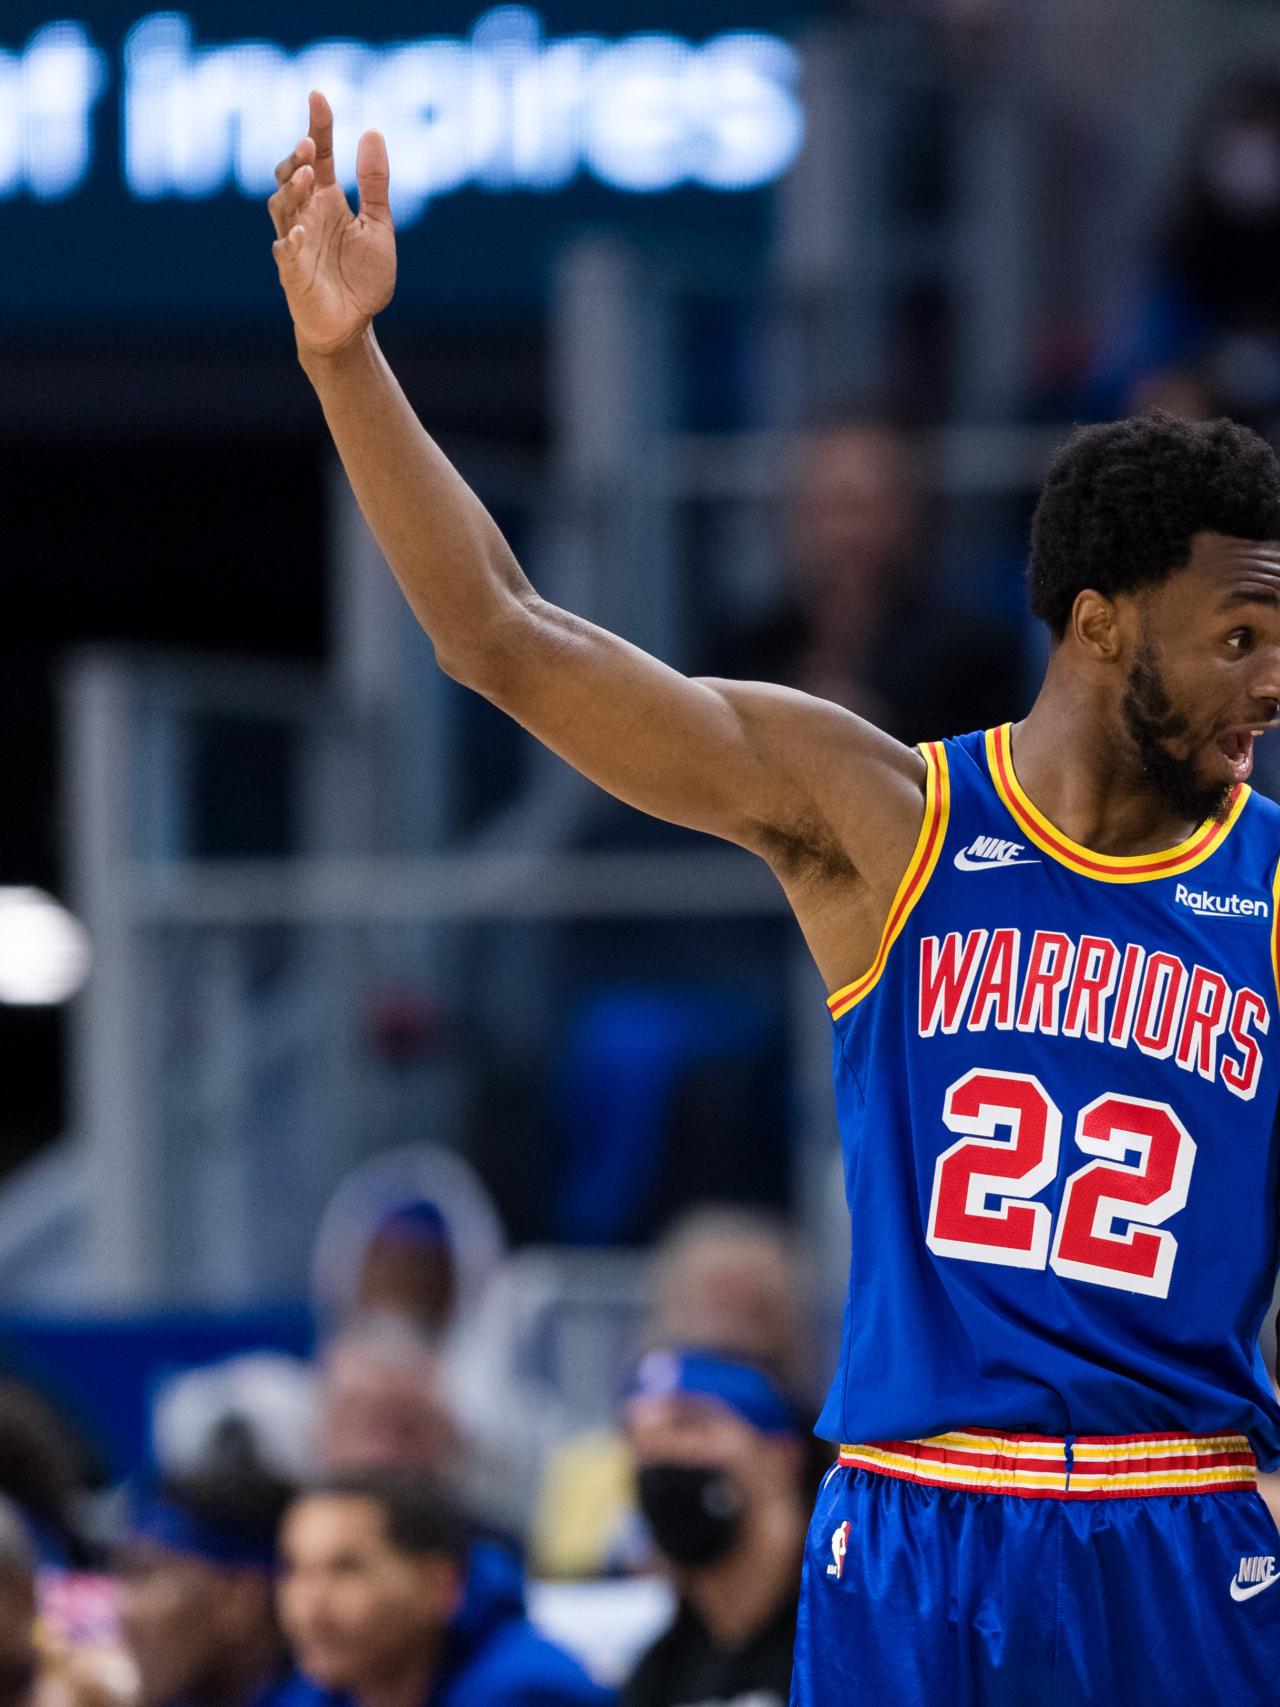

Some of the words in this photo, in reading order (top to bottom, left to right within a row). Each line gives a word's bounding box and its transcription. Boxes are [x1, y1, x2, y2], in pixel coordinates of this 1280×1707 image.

[967, 835, 1025, 862] NIKE
[1175, 883, 1268, 918] Rakuten
[918, 928, 1270, 1101] WARRIORS
[926, 1067, 1197, 1299] 22
[1238, 1556, 1275, 1583] NIKE
